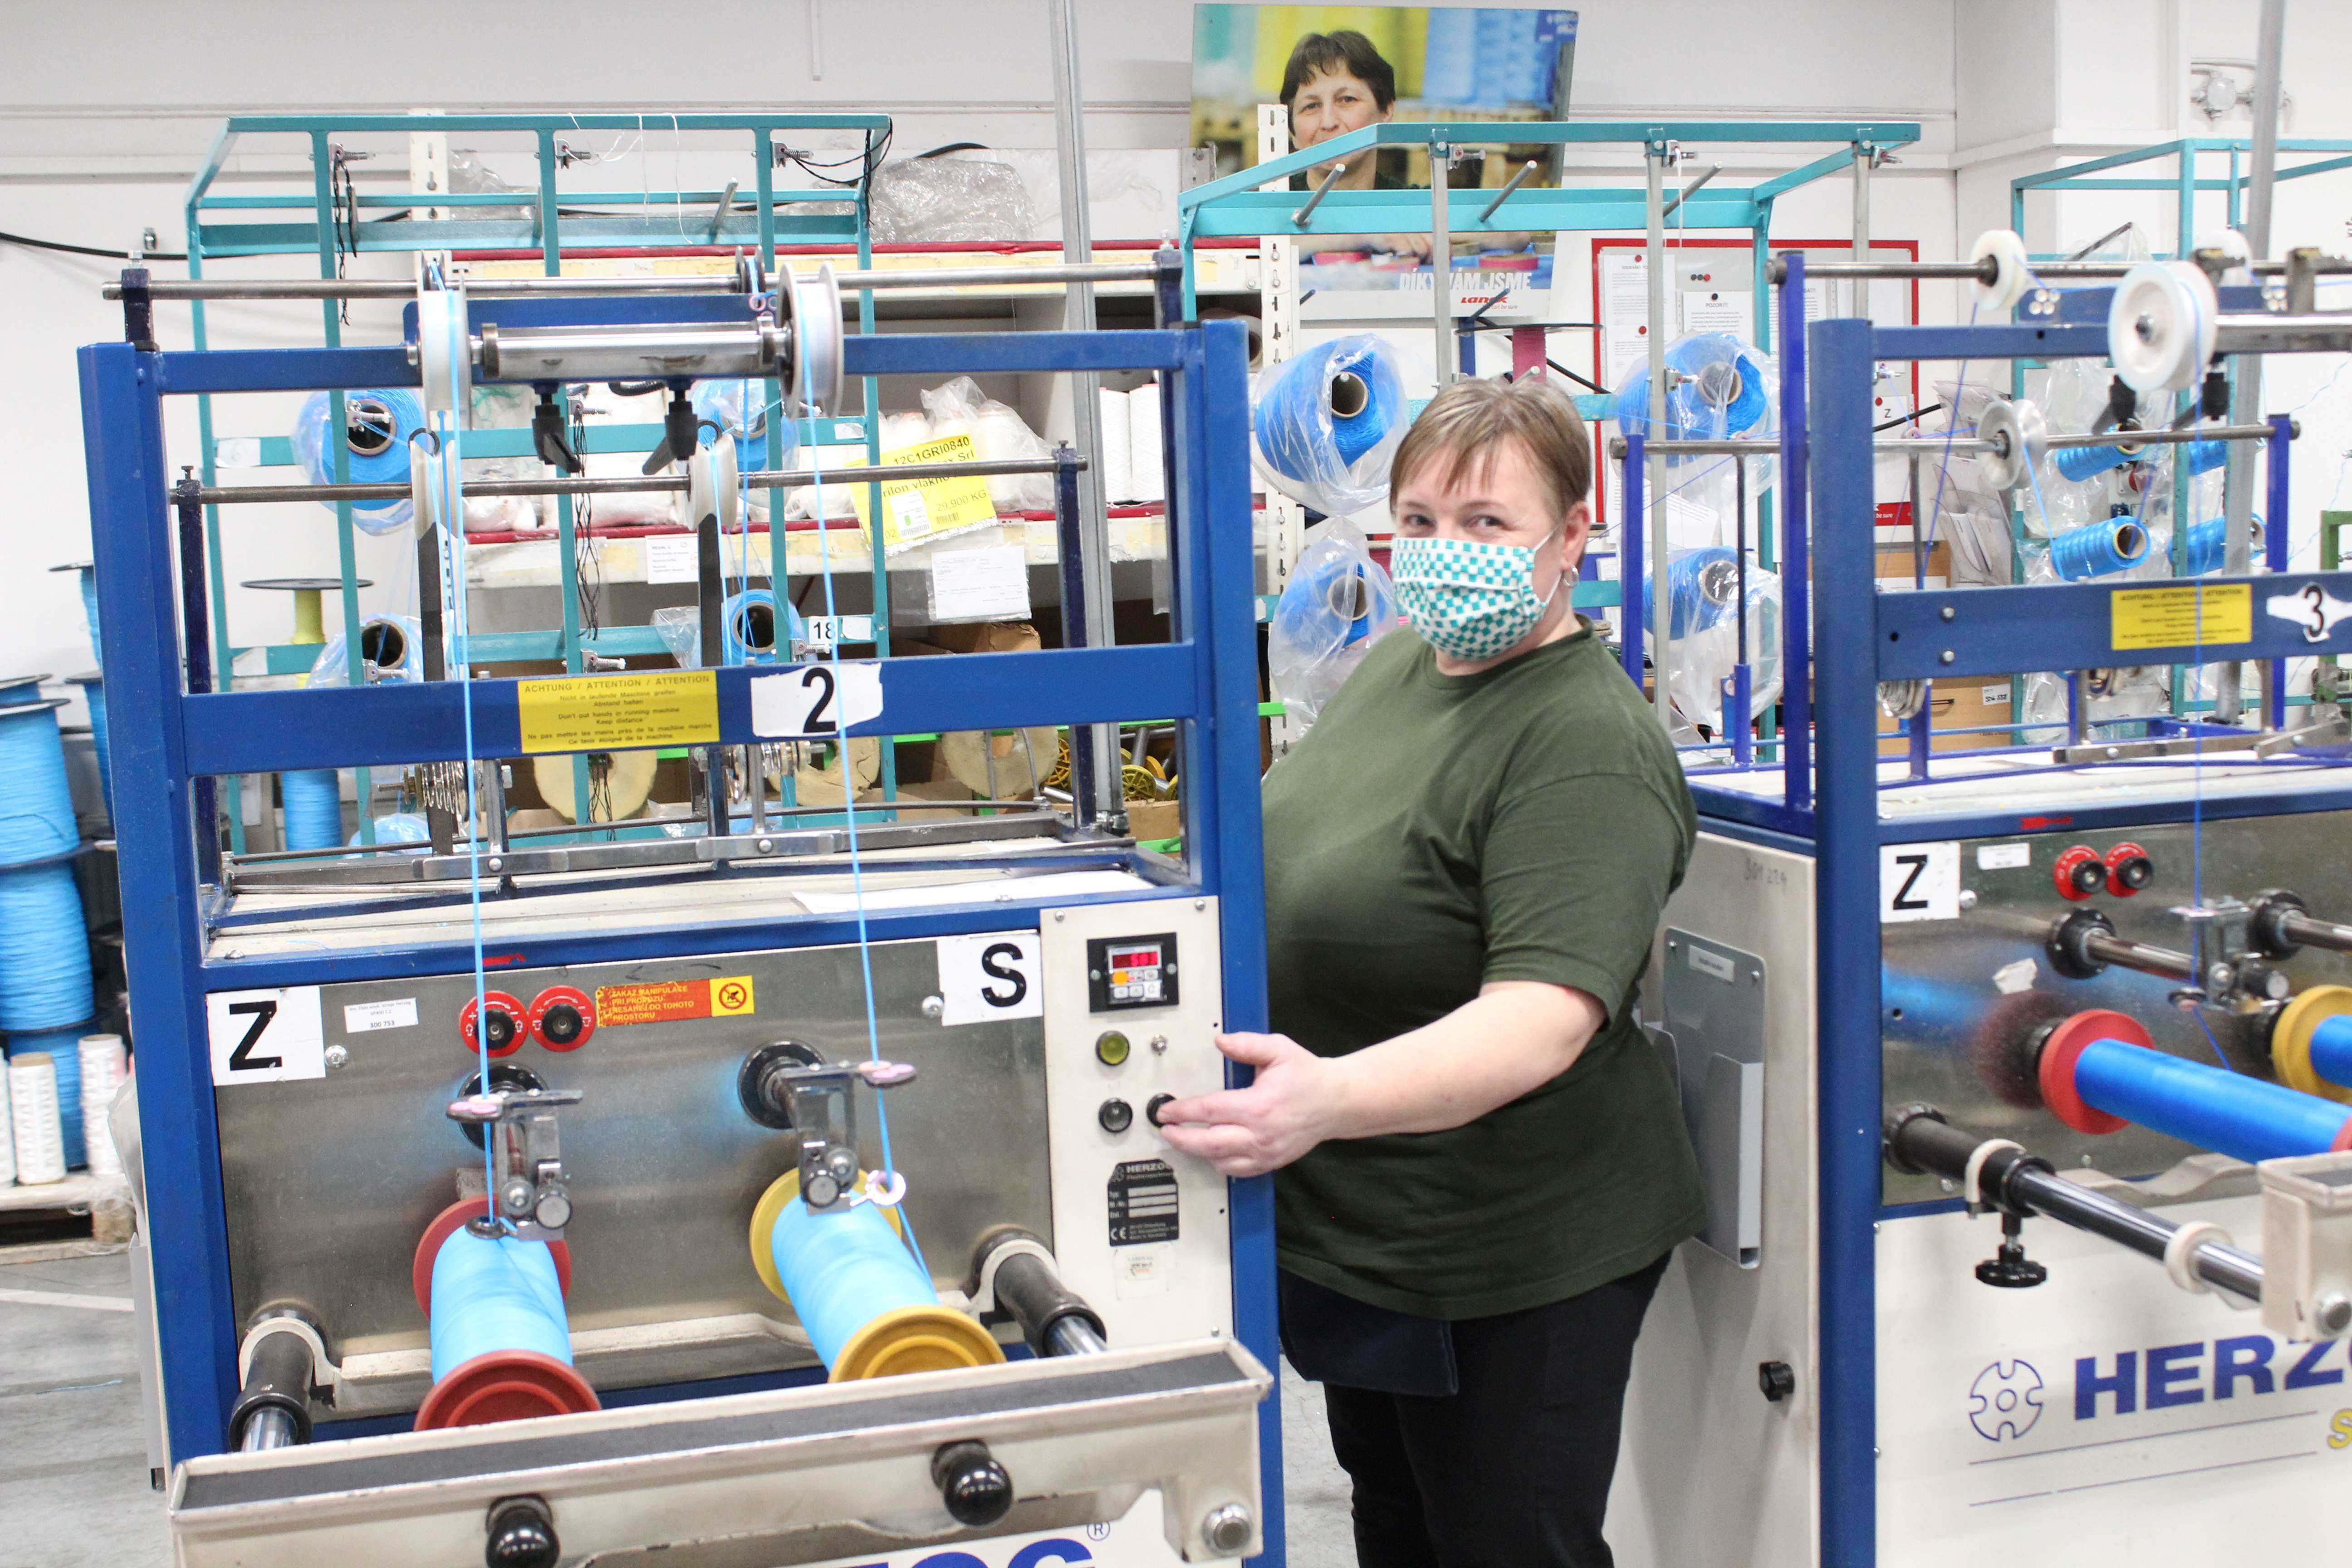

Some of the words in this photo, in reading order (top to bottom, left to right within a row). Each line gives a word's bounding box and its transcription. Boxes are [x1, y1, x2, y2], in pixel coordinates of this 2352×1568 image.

[1483, 272, 1532, 289] JSME
[1884, 409, 1891, 418] Z
[971, 490, 987, 502] KG
[2304, 585, 2324, 637] 3
[813, 622, 836, 639] 18
[525, 683, 572, 692] ACHTUNG
[587, 679, 641, 690] ATTENTION
[656, 675, 710, 685] ATTENTION
[802, 667, 836, 733] 2
[1893, 854, 1928, 910] Z
[981, 942, 1027, 1007] S
[663, 1000, 694, 1009] TOHOTO
[612, 1012, 656, 1021] PROSTORU
[229, 1000, 282, 1071] Z
[1126, 1162, 1172, 1173] HERZO
[2075, 1334, 2352, 1421] HERZ
